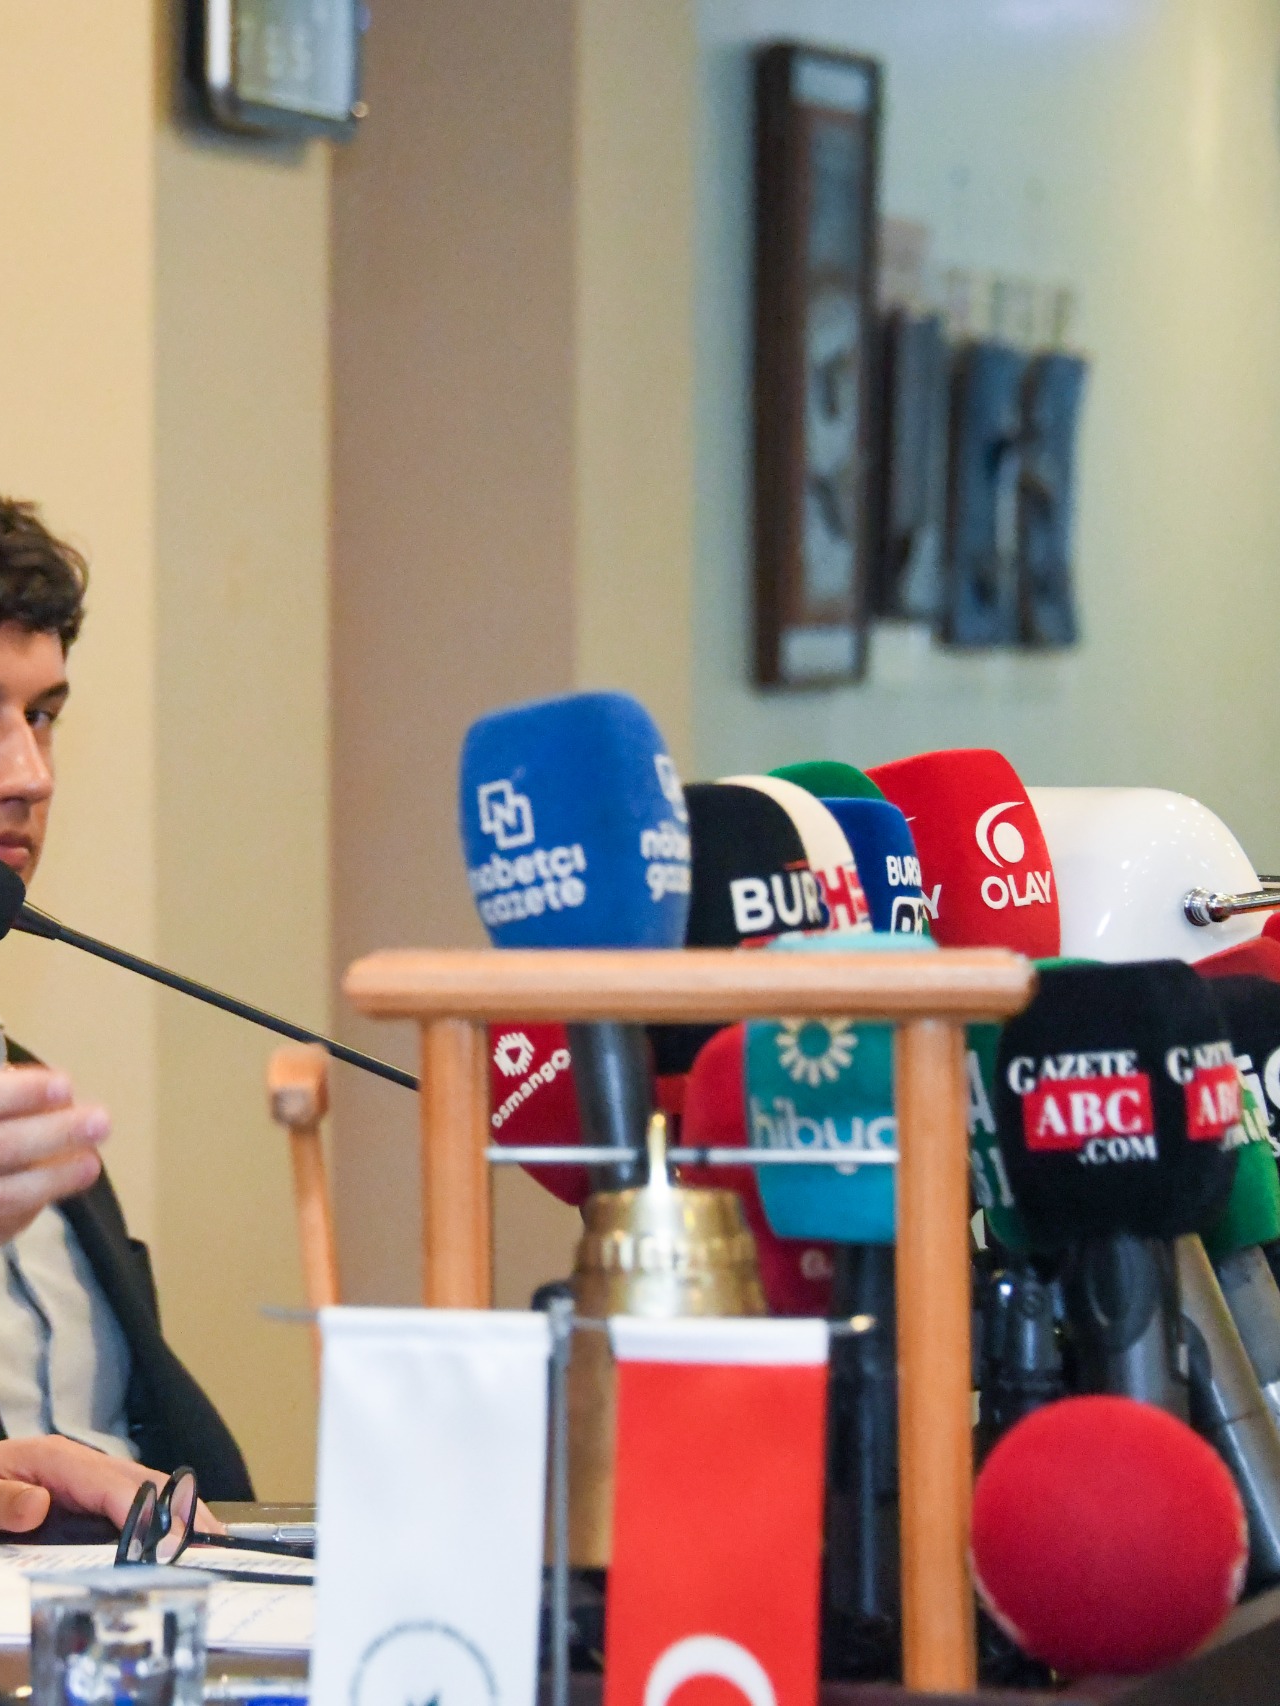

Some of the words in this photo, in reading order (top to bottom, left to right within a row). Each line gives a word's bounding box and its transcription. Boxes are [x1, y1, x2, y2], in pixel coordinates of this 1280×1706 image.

[981, 871, 1051, 910] OLAY
[1007, 1050, 1138, 1095] GAZETE
[1037, 1088, 1142, 1137] ABC
[1078, 1135, 1157, 1166] .COM
